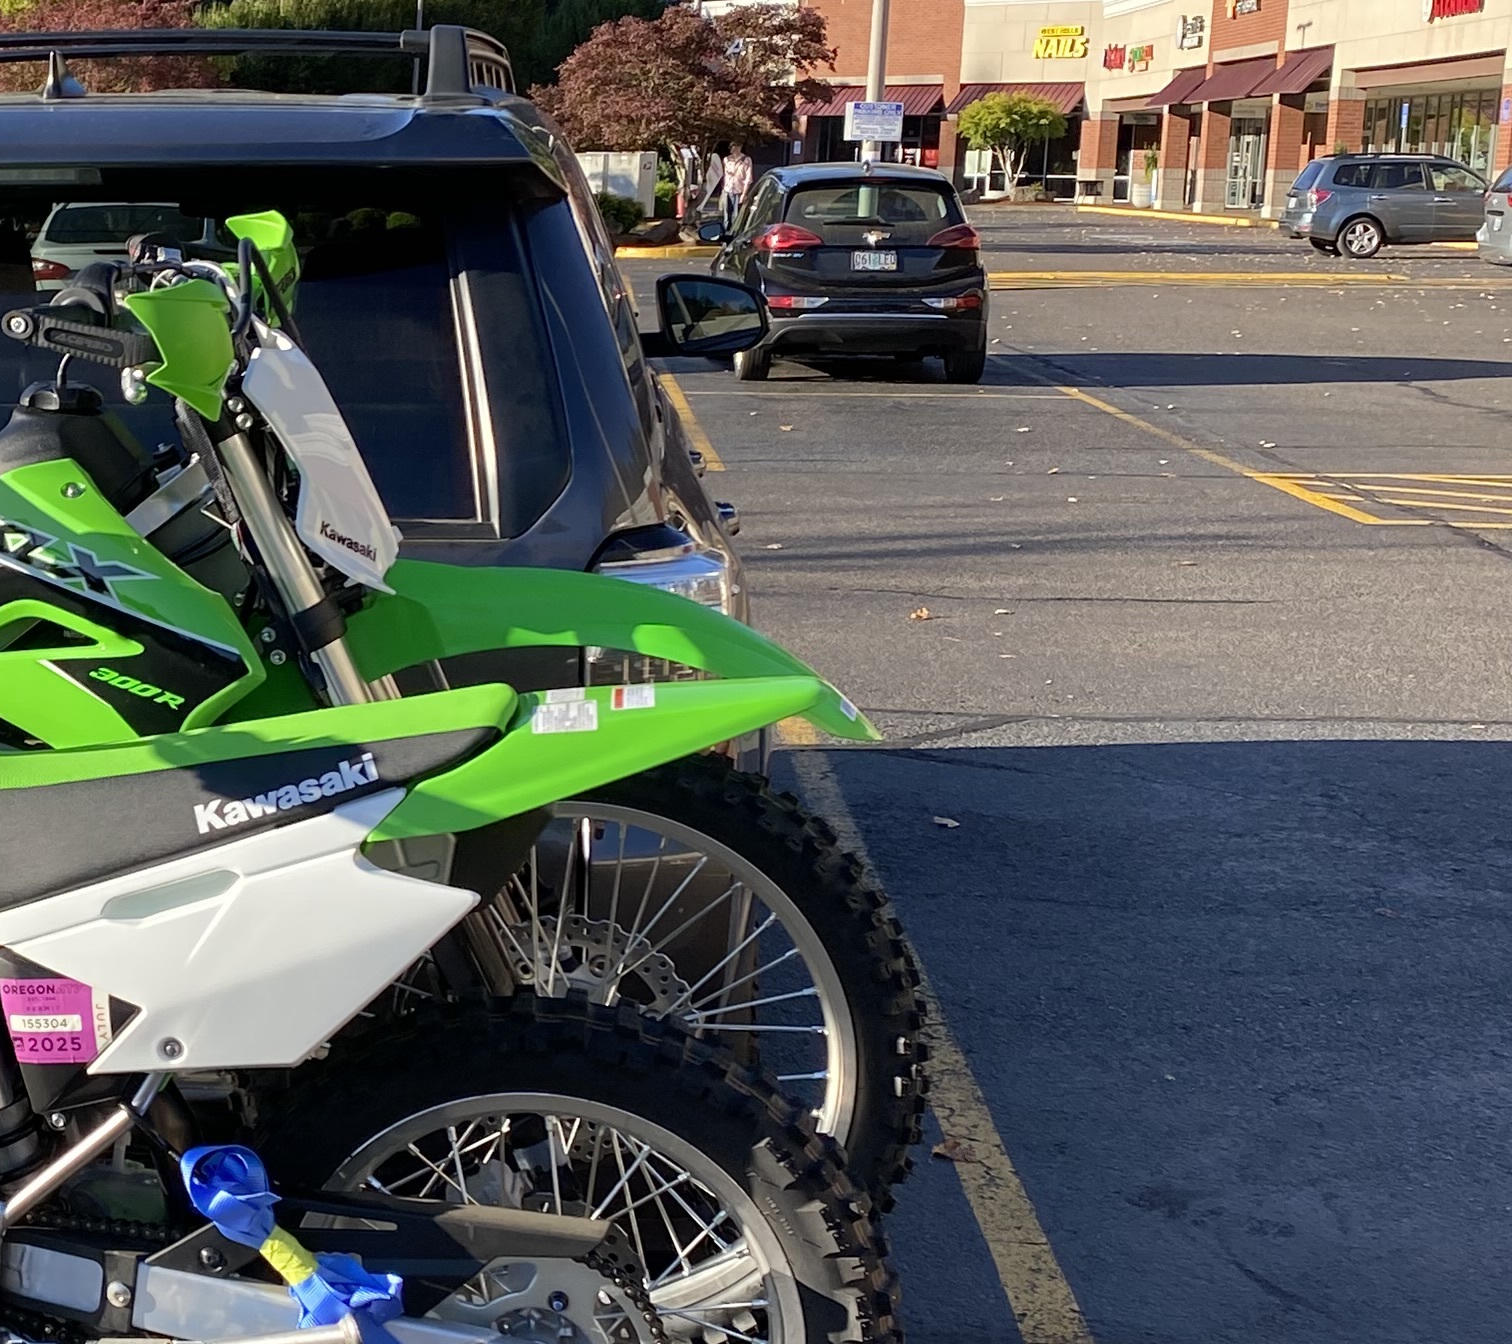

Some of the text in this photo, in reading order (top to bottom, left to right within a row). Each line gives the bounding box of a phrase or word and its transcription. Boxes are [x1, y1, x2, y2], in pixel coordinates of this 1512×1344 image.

[1032, 38, 1089, 59] NAILS
[320, 521, 377, 562] Kawasaki
[89, 667, 185, 711] 300R
[193, 752, 380, 835] Kawasaki
[2, 984, 56, 995] OREGON
[21, 1018, 68, 1029] 155304
[95, 1003, 109, 1041] JULY
[28, 1036, 82, 1052] 2025
